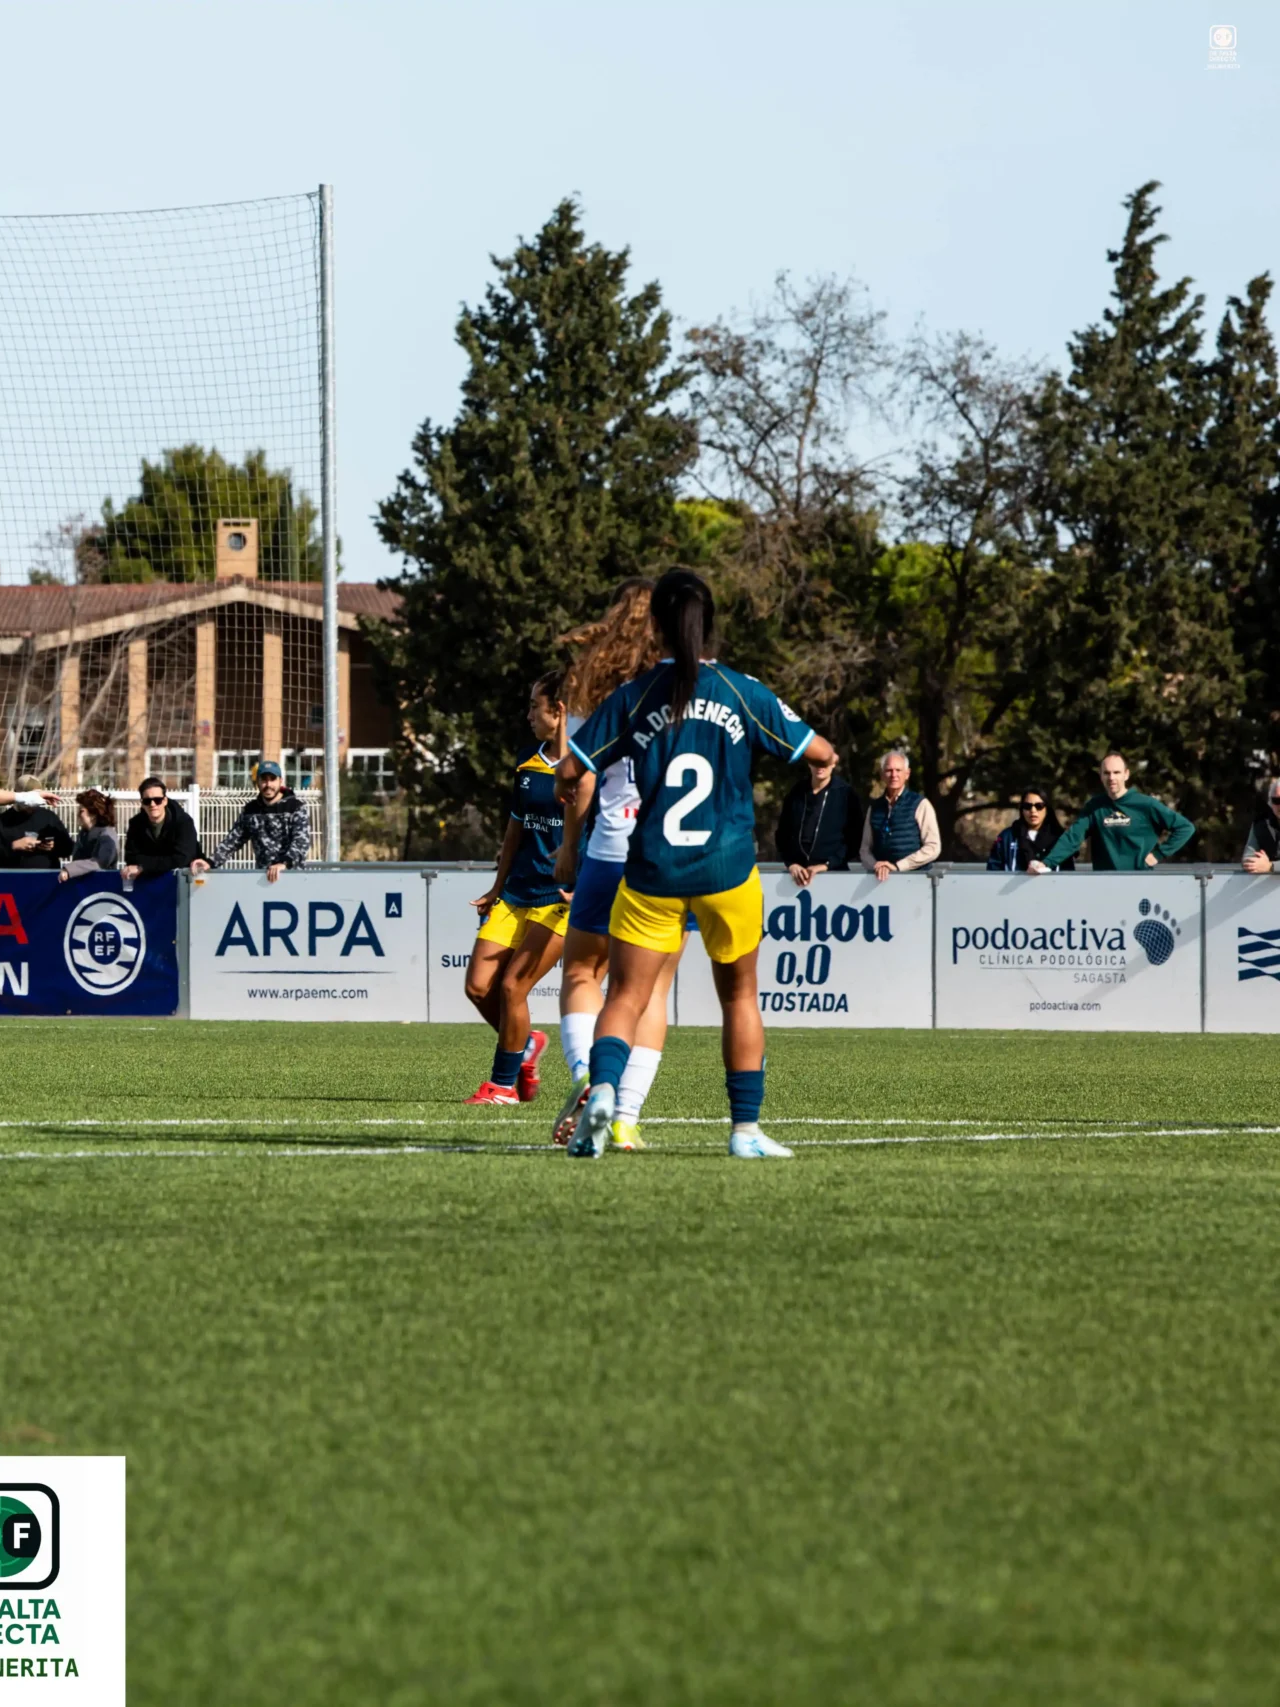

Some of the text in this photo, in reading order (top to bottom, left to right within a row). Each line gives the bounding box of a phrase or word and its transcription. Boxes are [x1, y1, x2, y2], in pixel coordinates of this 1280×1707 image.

[663, 752, 714, 847] 2
[763, 888, 895, 943] ahou
[94, 931, 115, 943] RF
[215, 901, 386, 957] ARPA
[94, 944, 116, 955] EF
[952, 918, 1127, 965] podoactiva
[775, 943, 832, 988] 0,0
[979, 952, 1127, 966] CLÍNICA PODOLÓGICA
[1073, 972, 1127, 984] SAGASTA
[247, 985, 369, 1001] www.arpaemc.com
[759, 992, 850, 1013] TOSTADA
[1029, 1001, 1102, 1012] podoactiva.com
